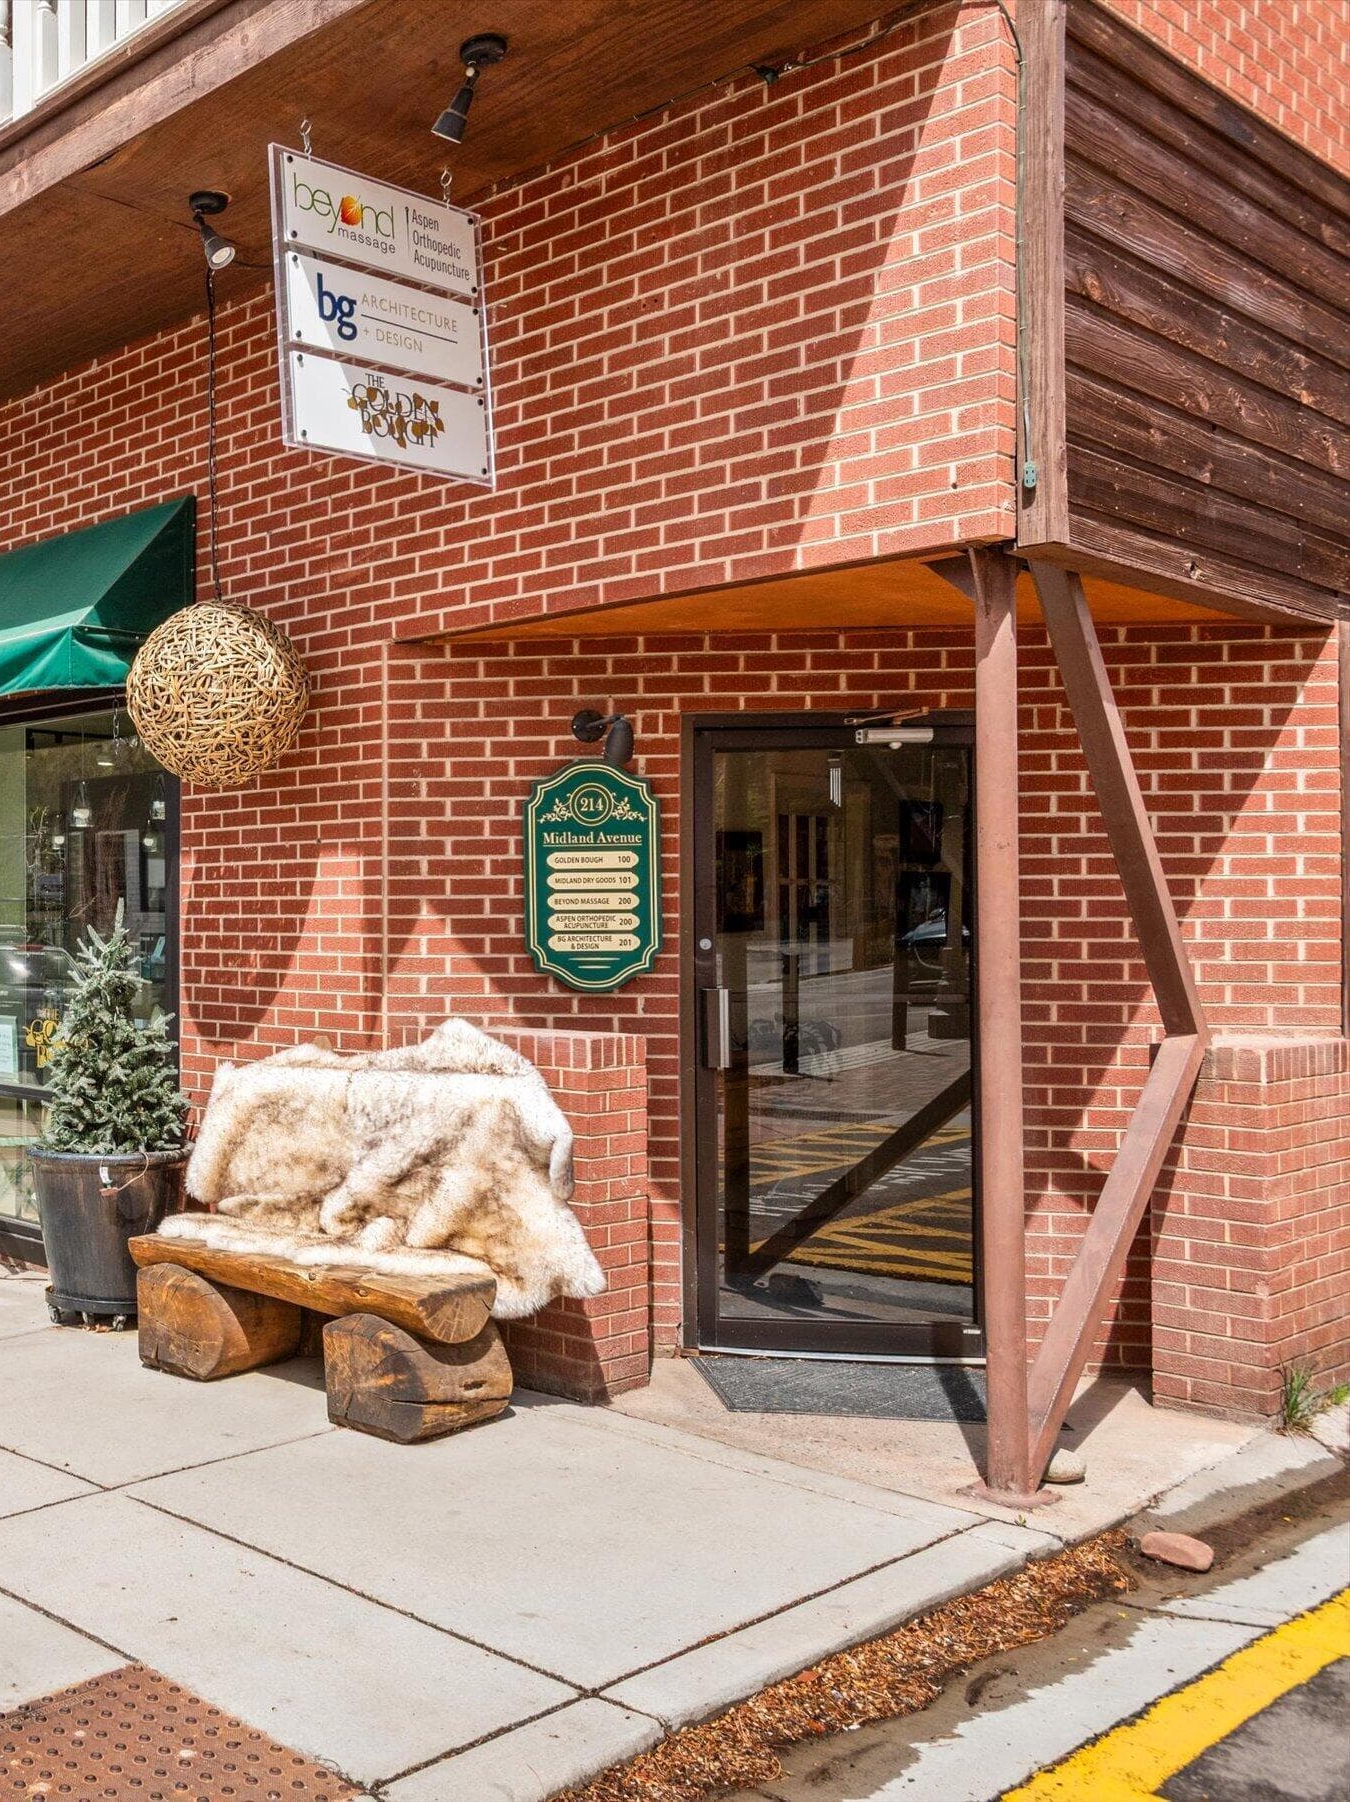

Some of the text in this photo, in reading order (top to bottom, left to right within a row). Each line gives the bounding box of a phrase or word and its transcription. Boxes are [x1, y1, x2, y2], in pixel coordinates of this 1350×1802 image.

[411, 209, 440, 232] Aspen
[337, 225, 396, 254] massage
[412, 230, 461, 260] Orthopedic
[413, 249, 471, 281] Acupuncture
[316, 272, 358, 340] bg
[361, 293, 458, 333] ARCHITECTURE
[376, 328, 423, 352] DESIGN
[365, 373, 385, 389] THE
[580, 797, 604, 812] 214
[543, 831, 642, 844] Midland Avenue
[618, 855, 631, 863] 100
[596, 876, 616, 884] GOODS
[618, 876, 631, 884] 101
[618, 897, 632, 905] 200
[555, 915, 576, 923] ASPEN
[619, 918, 633, 926] 200
[557, 935, 612, 943] BG ARCHITECTURE
[619, 939, 632, 947] 201
